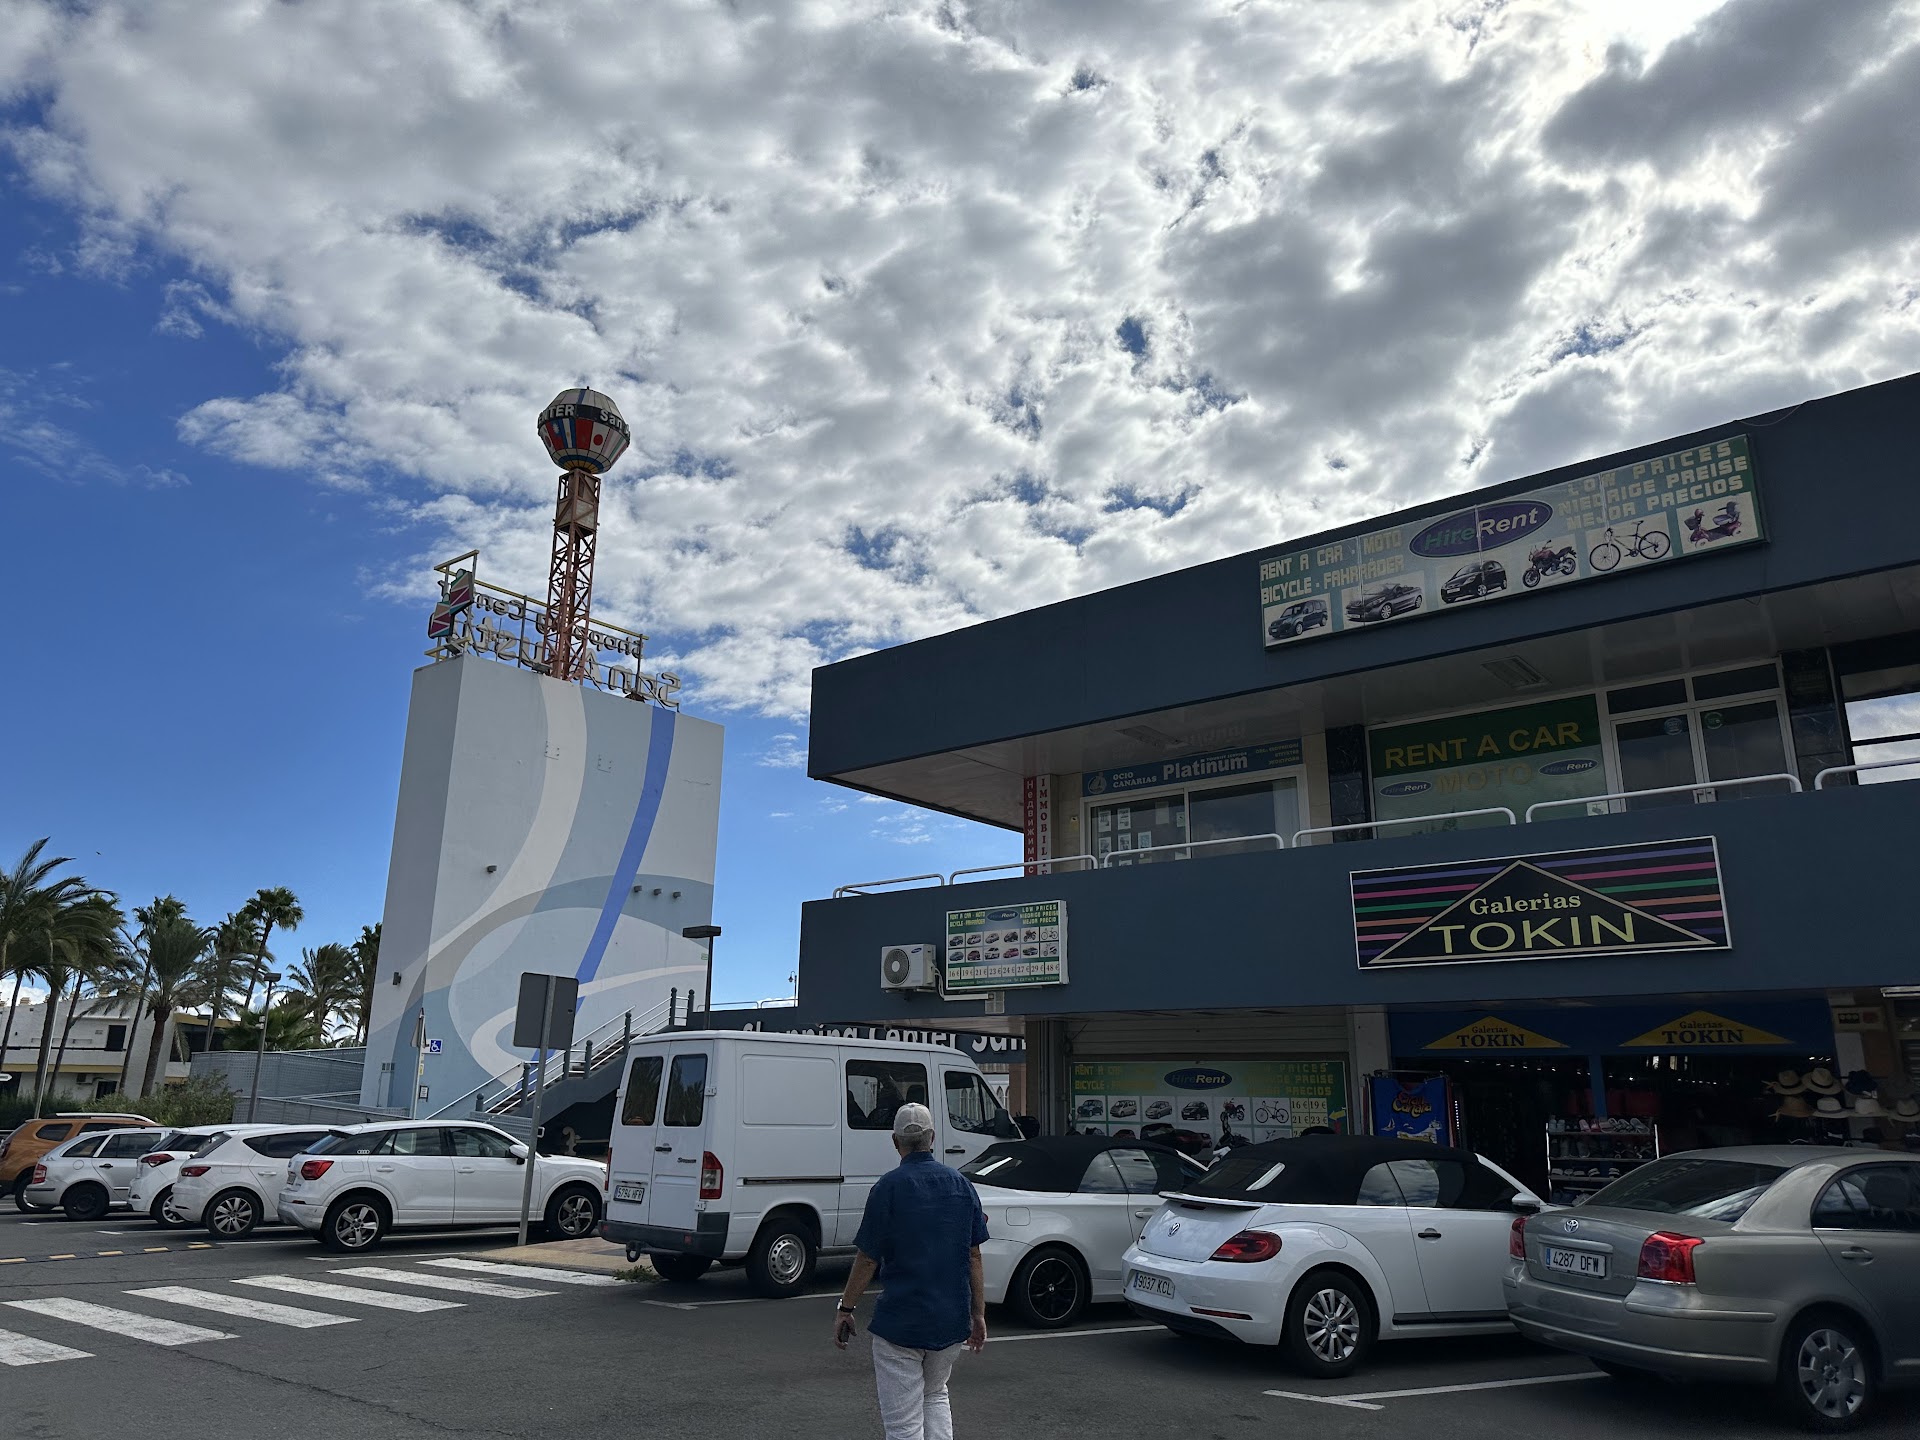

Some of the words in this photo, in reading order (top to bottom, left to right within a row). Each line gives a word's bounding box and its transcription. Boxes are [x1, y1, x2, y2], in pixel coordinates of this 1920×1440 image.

[600, 409, 623, 429] San
[1567, 471, 1617, 497] LOW
[1632, 442, 1732, 480] PRICES
[1557, 479, 1656, 517] NIEDRIGE
[1666, 455, 1748, 489] PREISE
[1567, 502, 1637, 531] MEJOR
[1646, 474, 1744, 511] PRECIOS
[1260, 557, 1292, 581] RENT
[1300, 553, 1309, 571] A
[1316, 544, 1343, 567] CAR
[1363, 530, 1402, 555] MOTO
[1261, 576, 1312, 604] BICYCLE
[1323, 554, 1405, 590] FAHRRÄDER
[1384, 738, 1468, 769] RENT
[1477, 735, 1500, 757] A
[1508, 721, 1583, 752] CAR
[1163, 755, 1249, 781] Platinum
[1112, 775, 1157, 789] CANARIAS
[1113, 771, 1134, 781] OCIO
[1436, 762, 1533, 794] MOTO
[1469, 892, 1582, 916] Galerias
[1428, 912, 1637, 955] TOKIN
[1472, 1025, 1508, 1034] Galerias
[1680, 1020, 1723, 1029] Galerias
[1456, 1033, 1525, 1047] TOKIN
[1661, 1029, 1744, 1044] TOKIN
[1279, 1063, 1327, 1073] PRICES
[1075, 1080, 1104, 1090] BICYCLE
[1295, 1074, 1334, 1084] PREISE
[1286, 1086, 1332, 1096] PRECIOS
[1292, 1101, 1301, 1109] 16
[1310, 1101, 1319, 1109] 19
[1292, 1115, 1301, 1124] 21
[1310, 1116, 1320, 1124] 23
[1553, 1251, 1575, 1268] 4287
[1580, 1255, 1599, 1272] DFW
[1138, 1275, 1156, 1291] 9037
[1156, 1280, 1171, 1296] KCL
